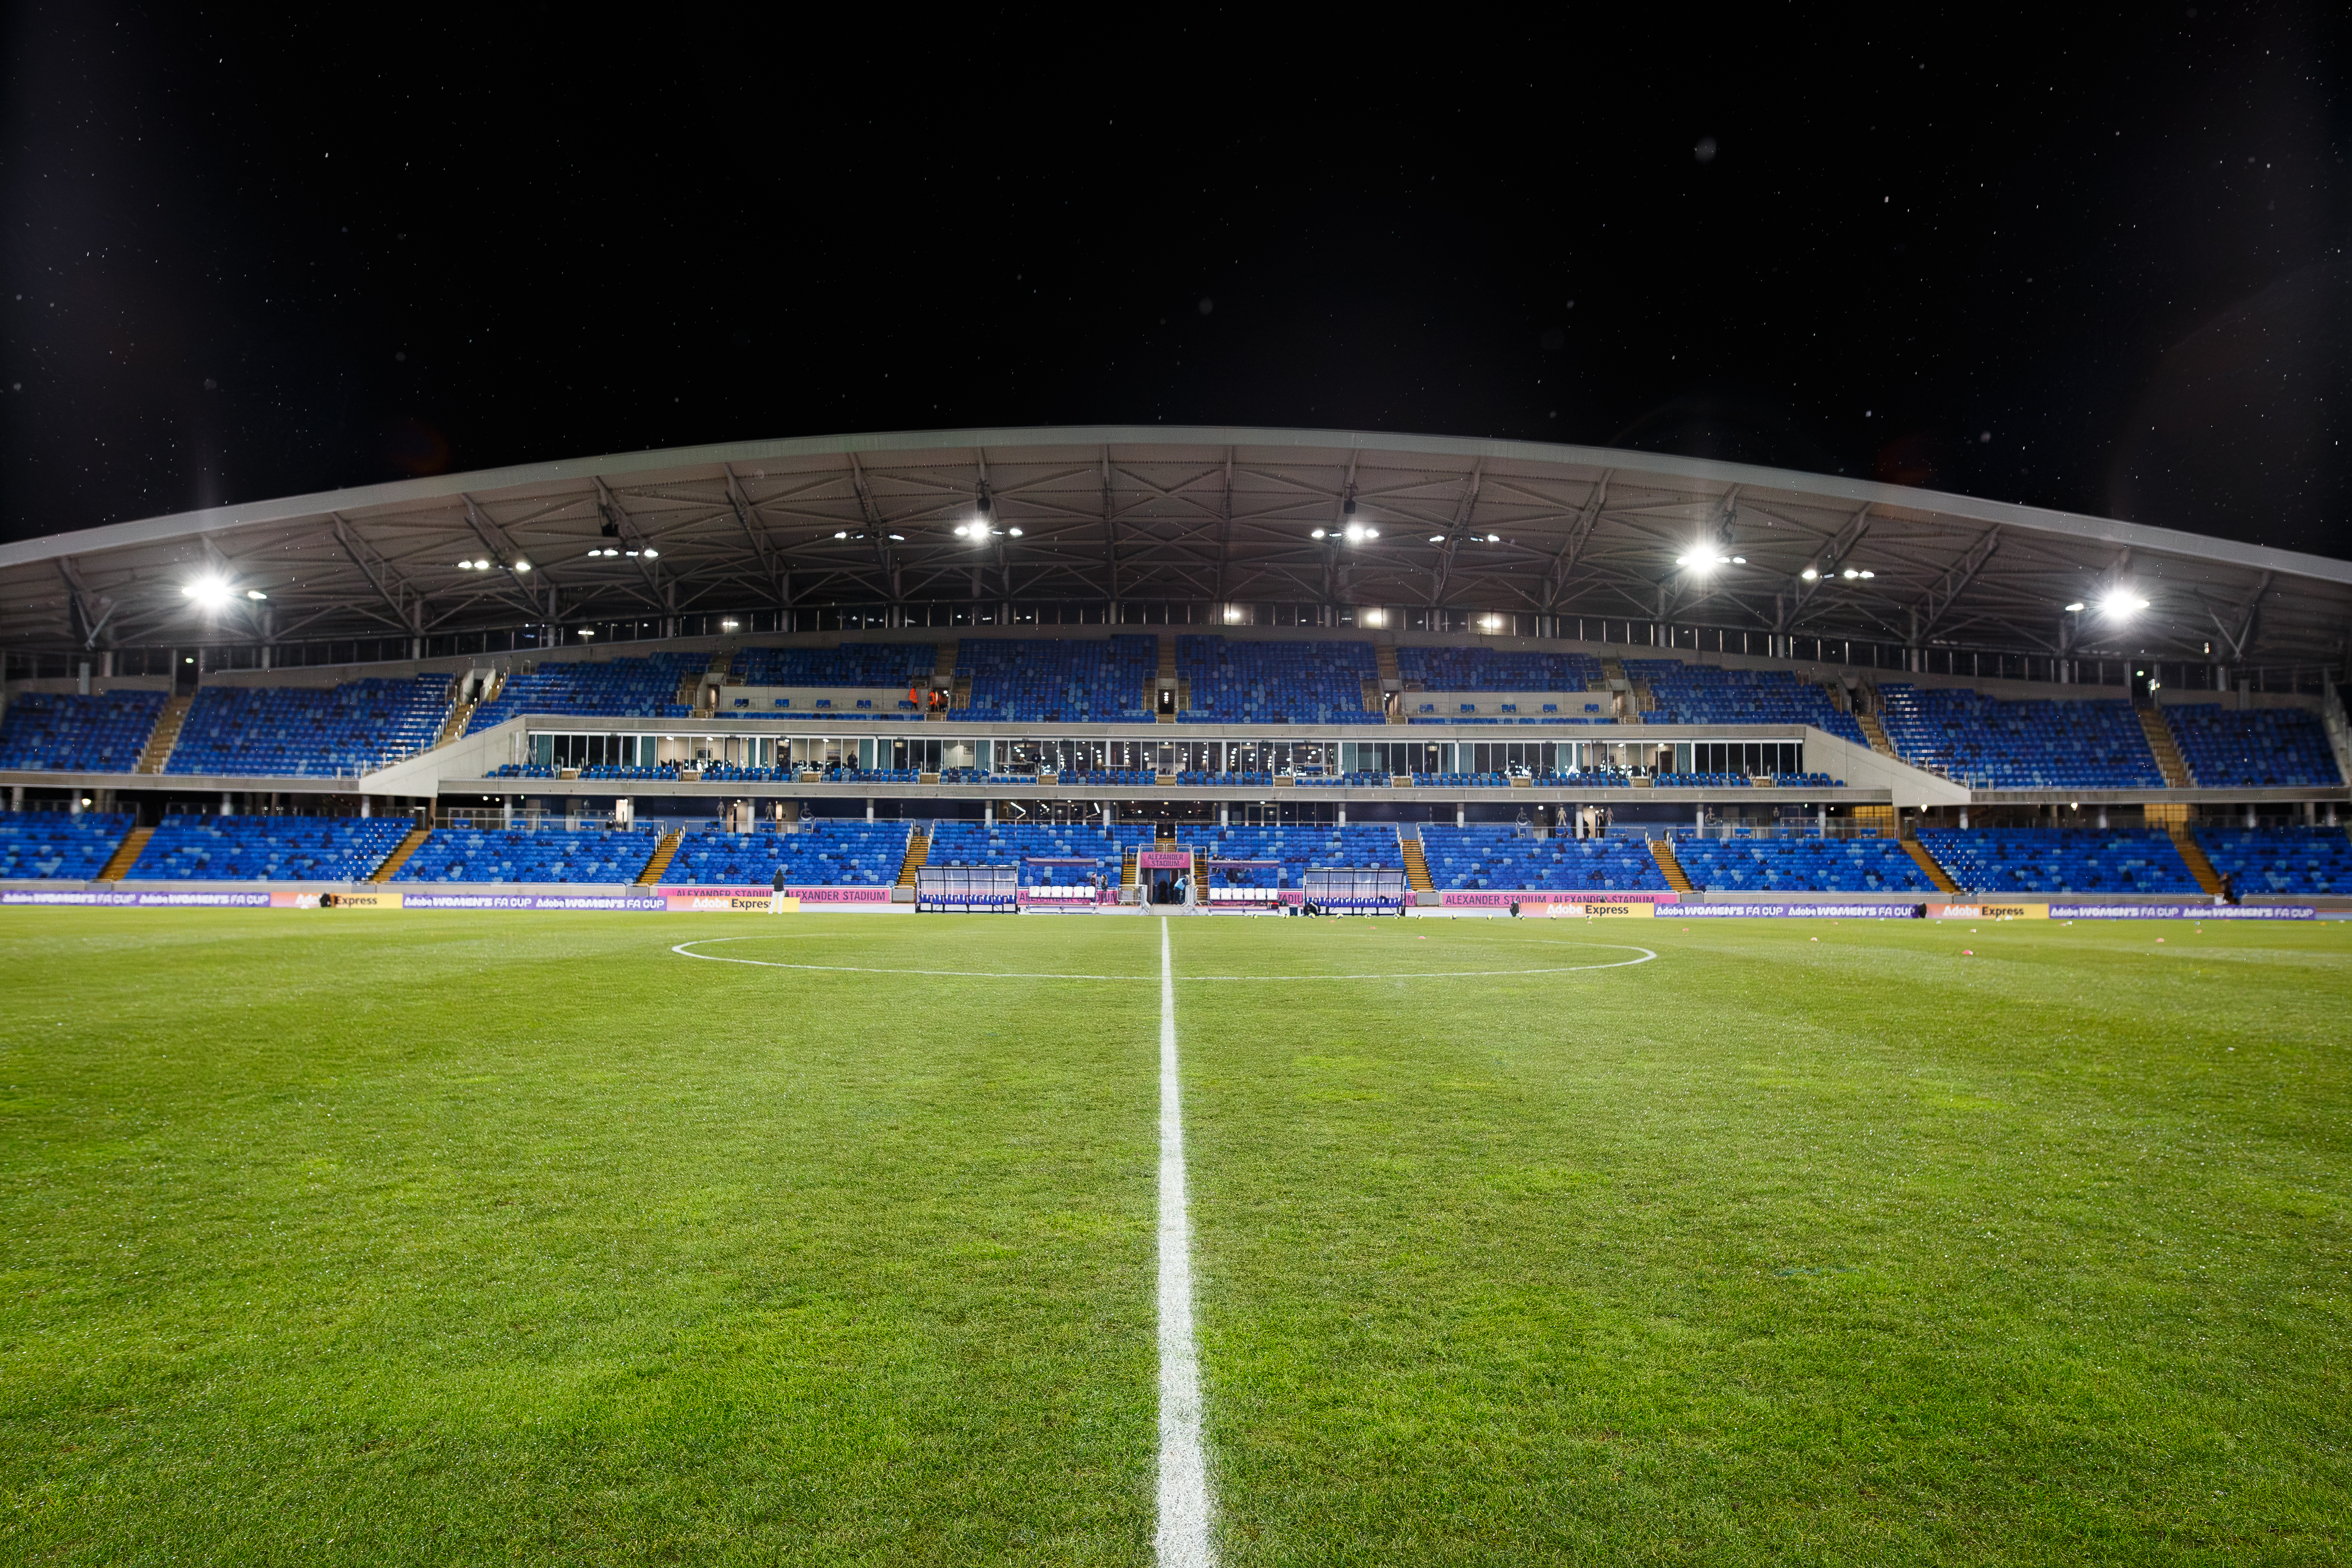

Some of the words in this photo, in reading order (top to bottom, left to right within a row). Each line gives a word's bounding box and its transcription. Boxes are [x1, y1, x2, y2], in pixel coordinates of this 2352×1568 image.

[98, 895, 112, 904] FA
[113, 894, 136, 904] CUP
[230, 895, 245, 904] FA
[247, 895, 269, 904] CUP
[842, 891, 885, 900] STADIUM
[1445, 896, 1499, 905] ALEXANDER
[1504, 895, 1546, 904] STADIUM
[295, 894, 322, 904] Ado
[334, 896, 377, 908] Express
[404, 897, 432, 906] Adobe
[433, 897, 493, 907] WOMEN'S
[494, 898, 508, 907] FA
[510, 898, 532, 907] CUP
[536, 899, 564, 907] Adobe
[565, 899, 625, 908] WOMEN'S
[627, 900, 640, 908] FA
[643, 900, 664, 908] CUP
[692, 898, 729, 908] Adobe
[1546, 904, 1583, 915] Adobe
[1586, 905, 1628, 916] Express
[1656, 907, 1684, 915] Adobe
[1685, 907, 1744, 915] WOMEN'S
[1746, 907, 1760, 915] FA
[1762, 907, 1783, 915] CUP
[1788, 907, 1816, 915] Adobe
[1817, 907, 1877, 916] WOMEN'S
[1879, 907, 1892, 916] FA
[1944, 906, 1979, 916] Adobe
[1982, 907, 2024, 918] Express
[2140, 907, 2155, 916] FA
[2158, 907, 2178, 916] CUP
[2274, 908, 2290, 917] FA
[2292, 909, 2313, 918] CUP
